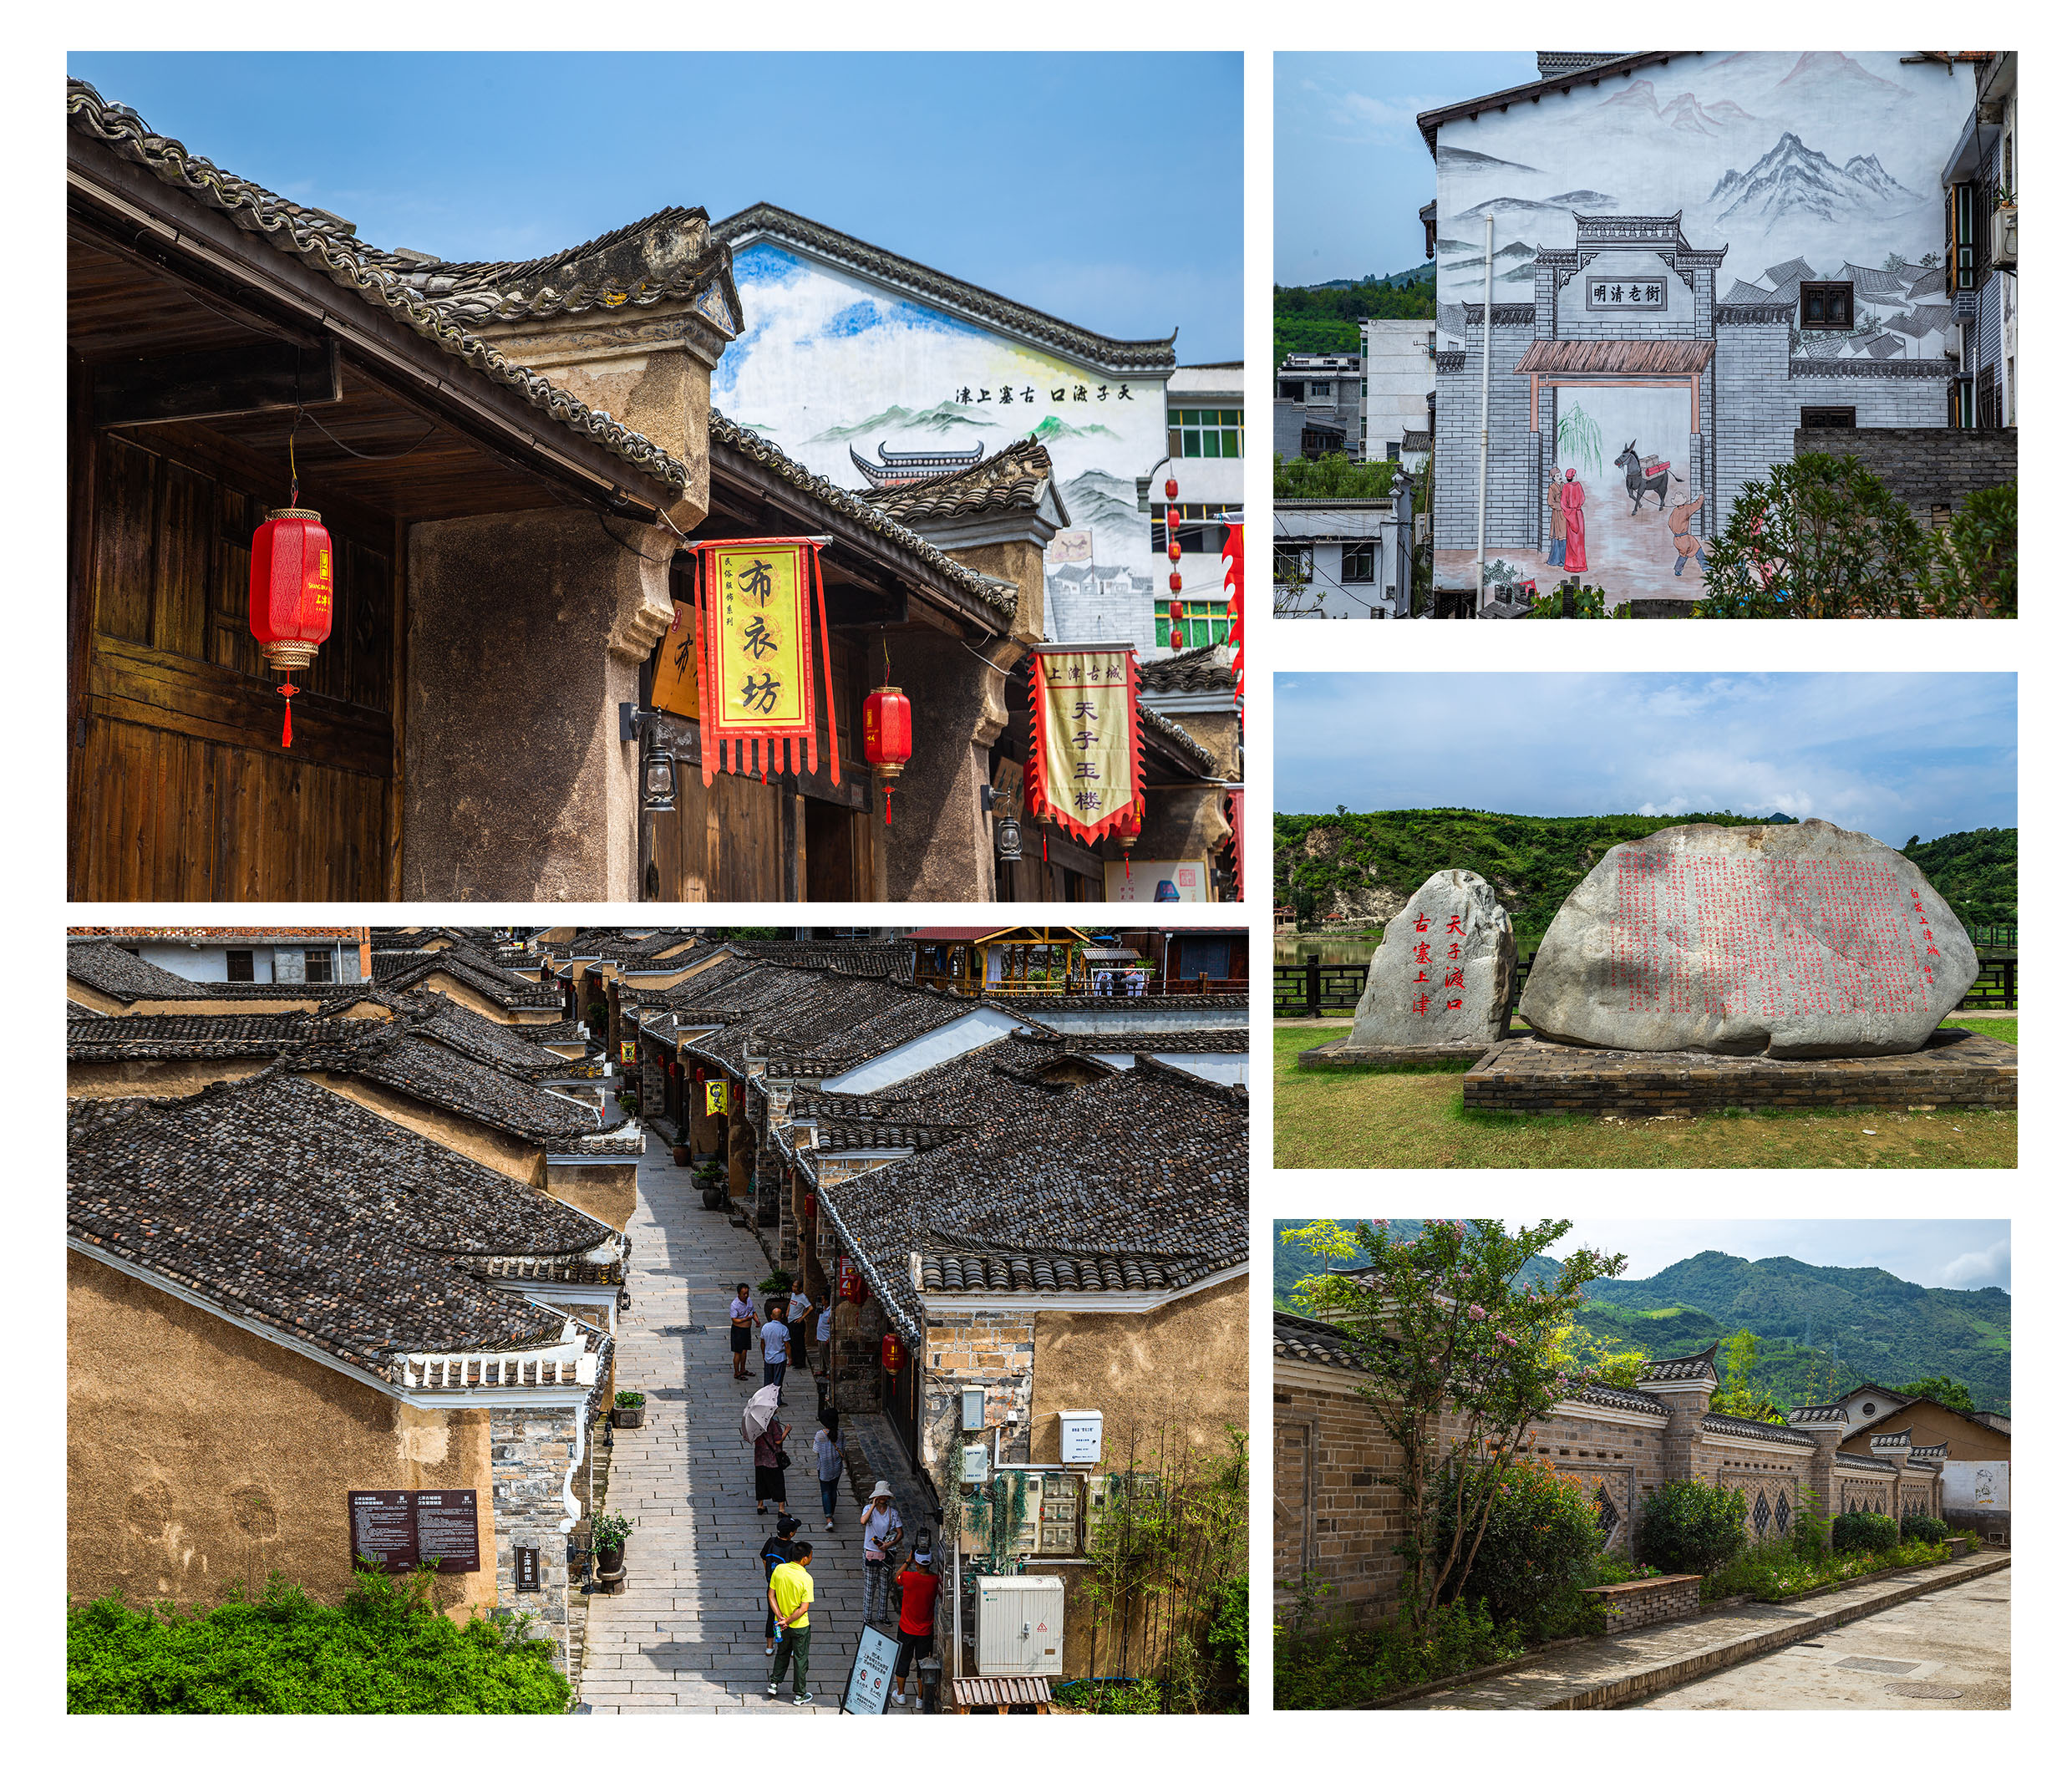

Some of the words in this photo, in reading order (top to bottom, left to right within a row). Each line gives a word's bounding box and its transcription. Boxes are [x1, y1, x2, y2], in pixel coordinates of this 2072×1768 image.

[1593, 284, 1661, 302] 明清老街
[724, 556, 734, 627] 民俗服饰系列
[738, 559, 781, 714] 布衣坊
[1049, 664, 1123, 683] 上津古城
[1071, 701, 1103, 811] 天子玉楼
[1412, 912, 1433, 1017] 古塞上津
[1445, 914, 1467, 1010] 天子渡口
[1911, 888, 1941, 958] 白发上津城
